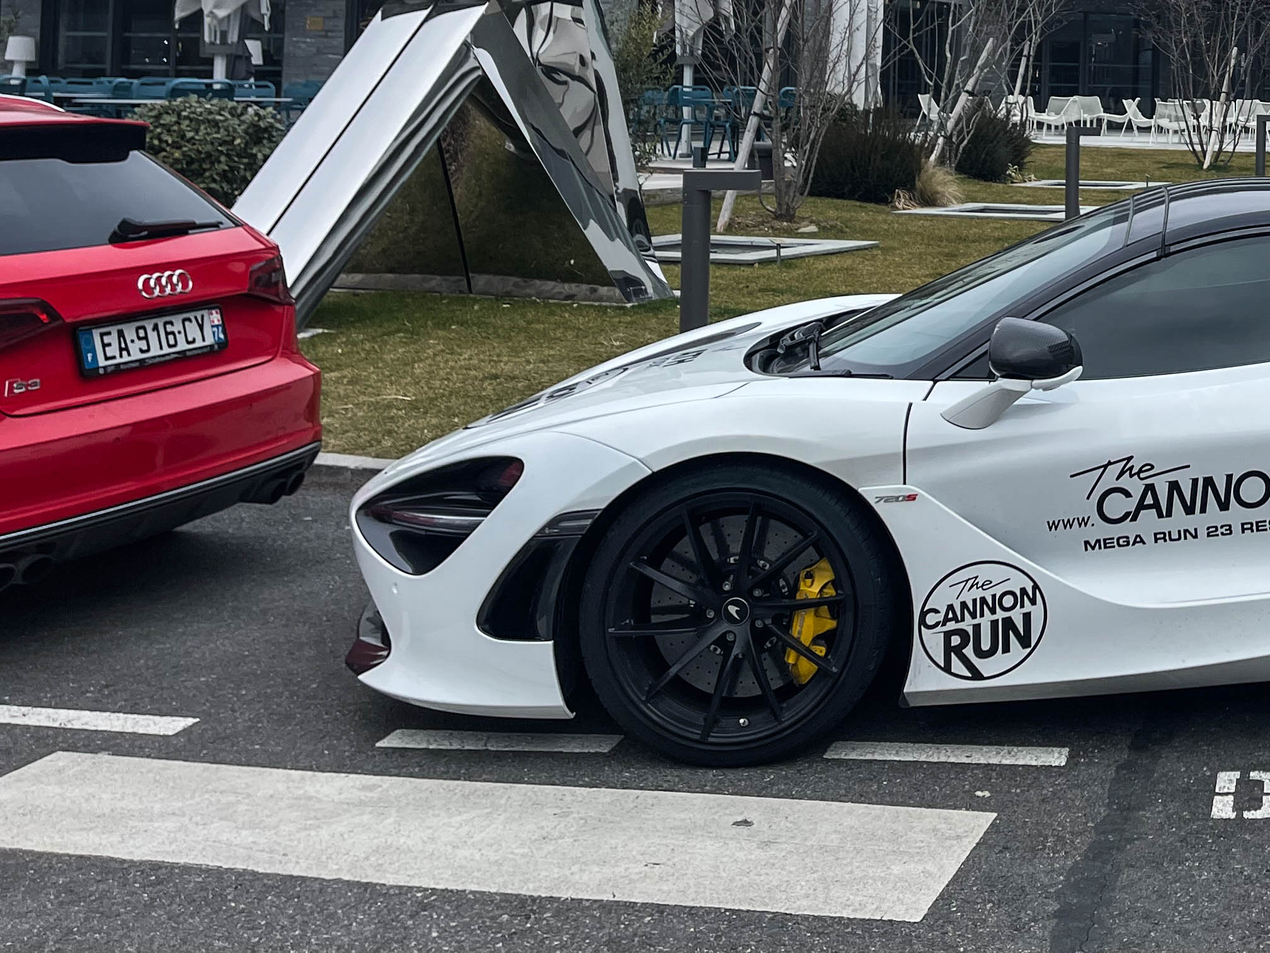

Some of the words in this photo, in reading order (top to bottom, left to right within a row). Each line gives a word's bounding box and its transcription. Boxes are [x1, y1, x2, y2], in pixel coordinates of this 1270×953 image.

[1070, 455, 1191, 500] The
[874, 493, 919, 505] 720S
[1083, 533, 1147, 552] MEGA
[1153, 527, 1199, 544] RUN
[1206, 523, 1234, 538] 23
[948, 574, 1012, 600] The
[920, 582, 1039, 631] CANNON
[931, 610, 1032, 680] RUN
